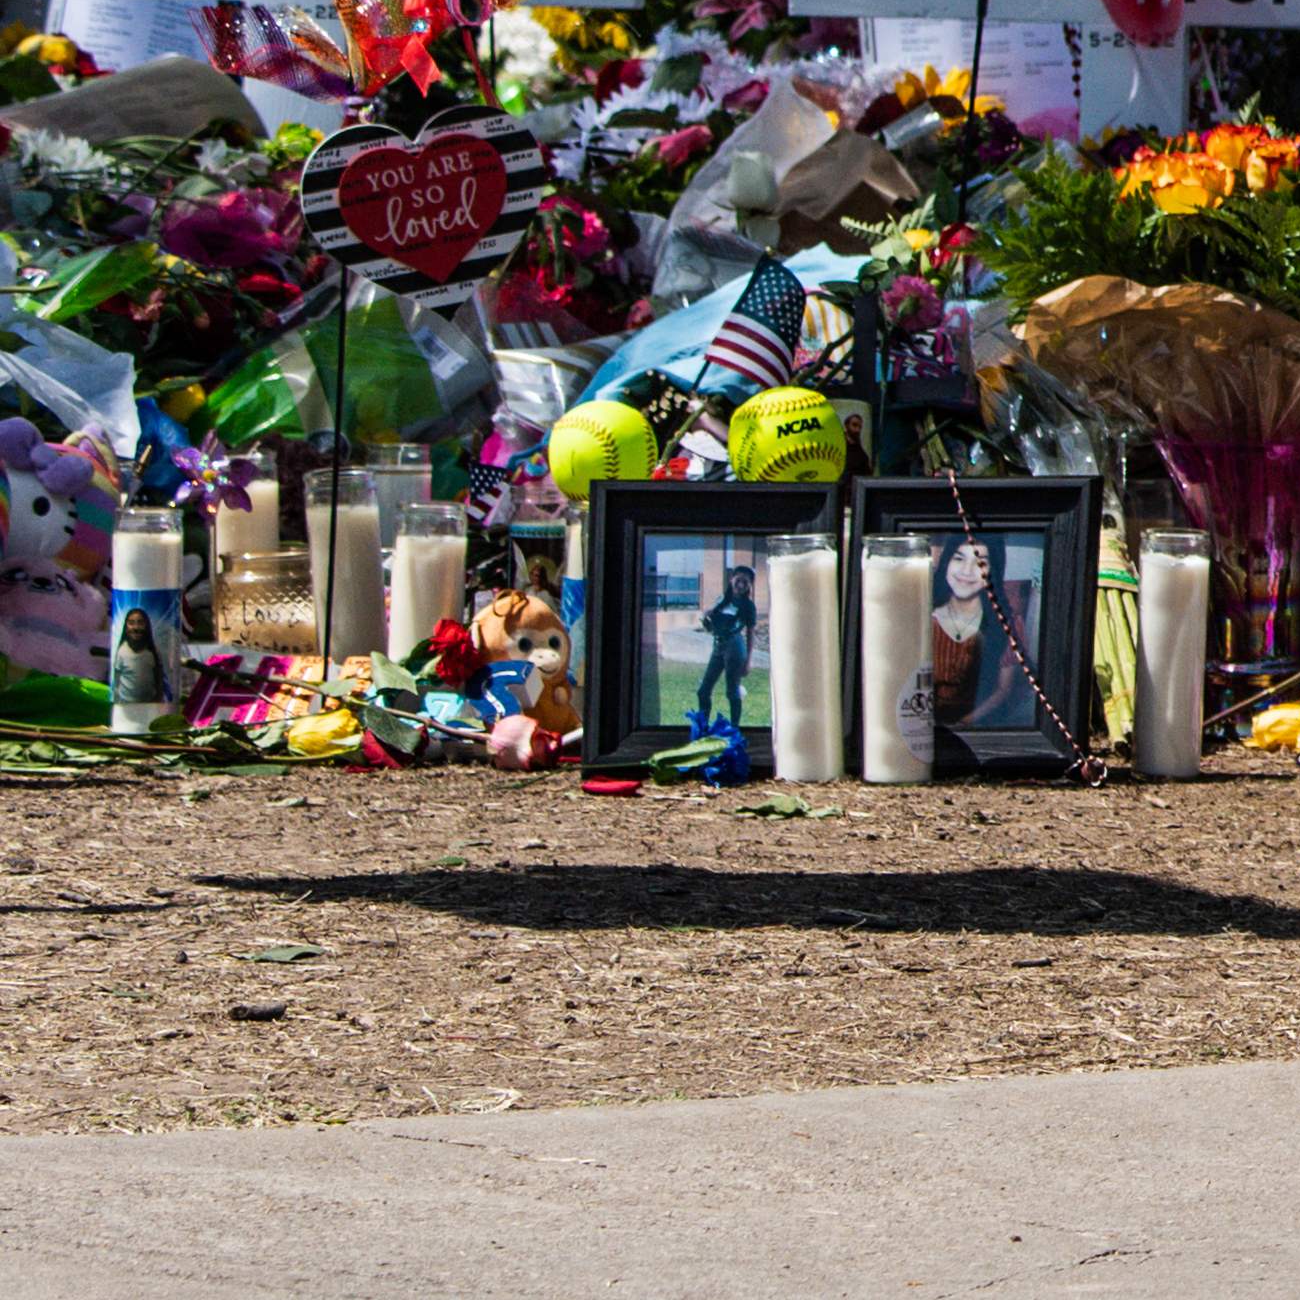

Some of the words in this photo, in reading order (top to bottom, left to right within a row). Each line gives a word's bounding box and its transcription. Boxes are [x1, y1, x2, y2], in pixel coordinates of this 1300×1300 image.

[366, 165, 415, 192] YOU
[426, 151, 473, 179] ARE
[374, 176, 479, 246] loved
[411, 185, 445, 208] SO
[776, 417, 824, 439] NCAA
